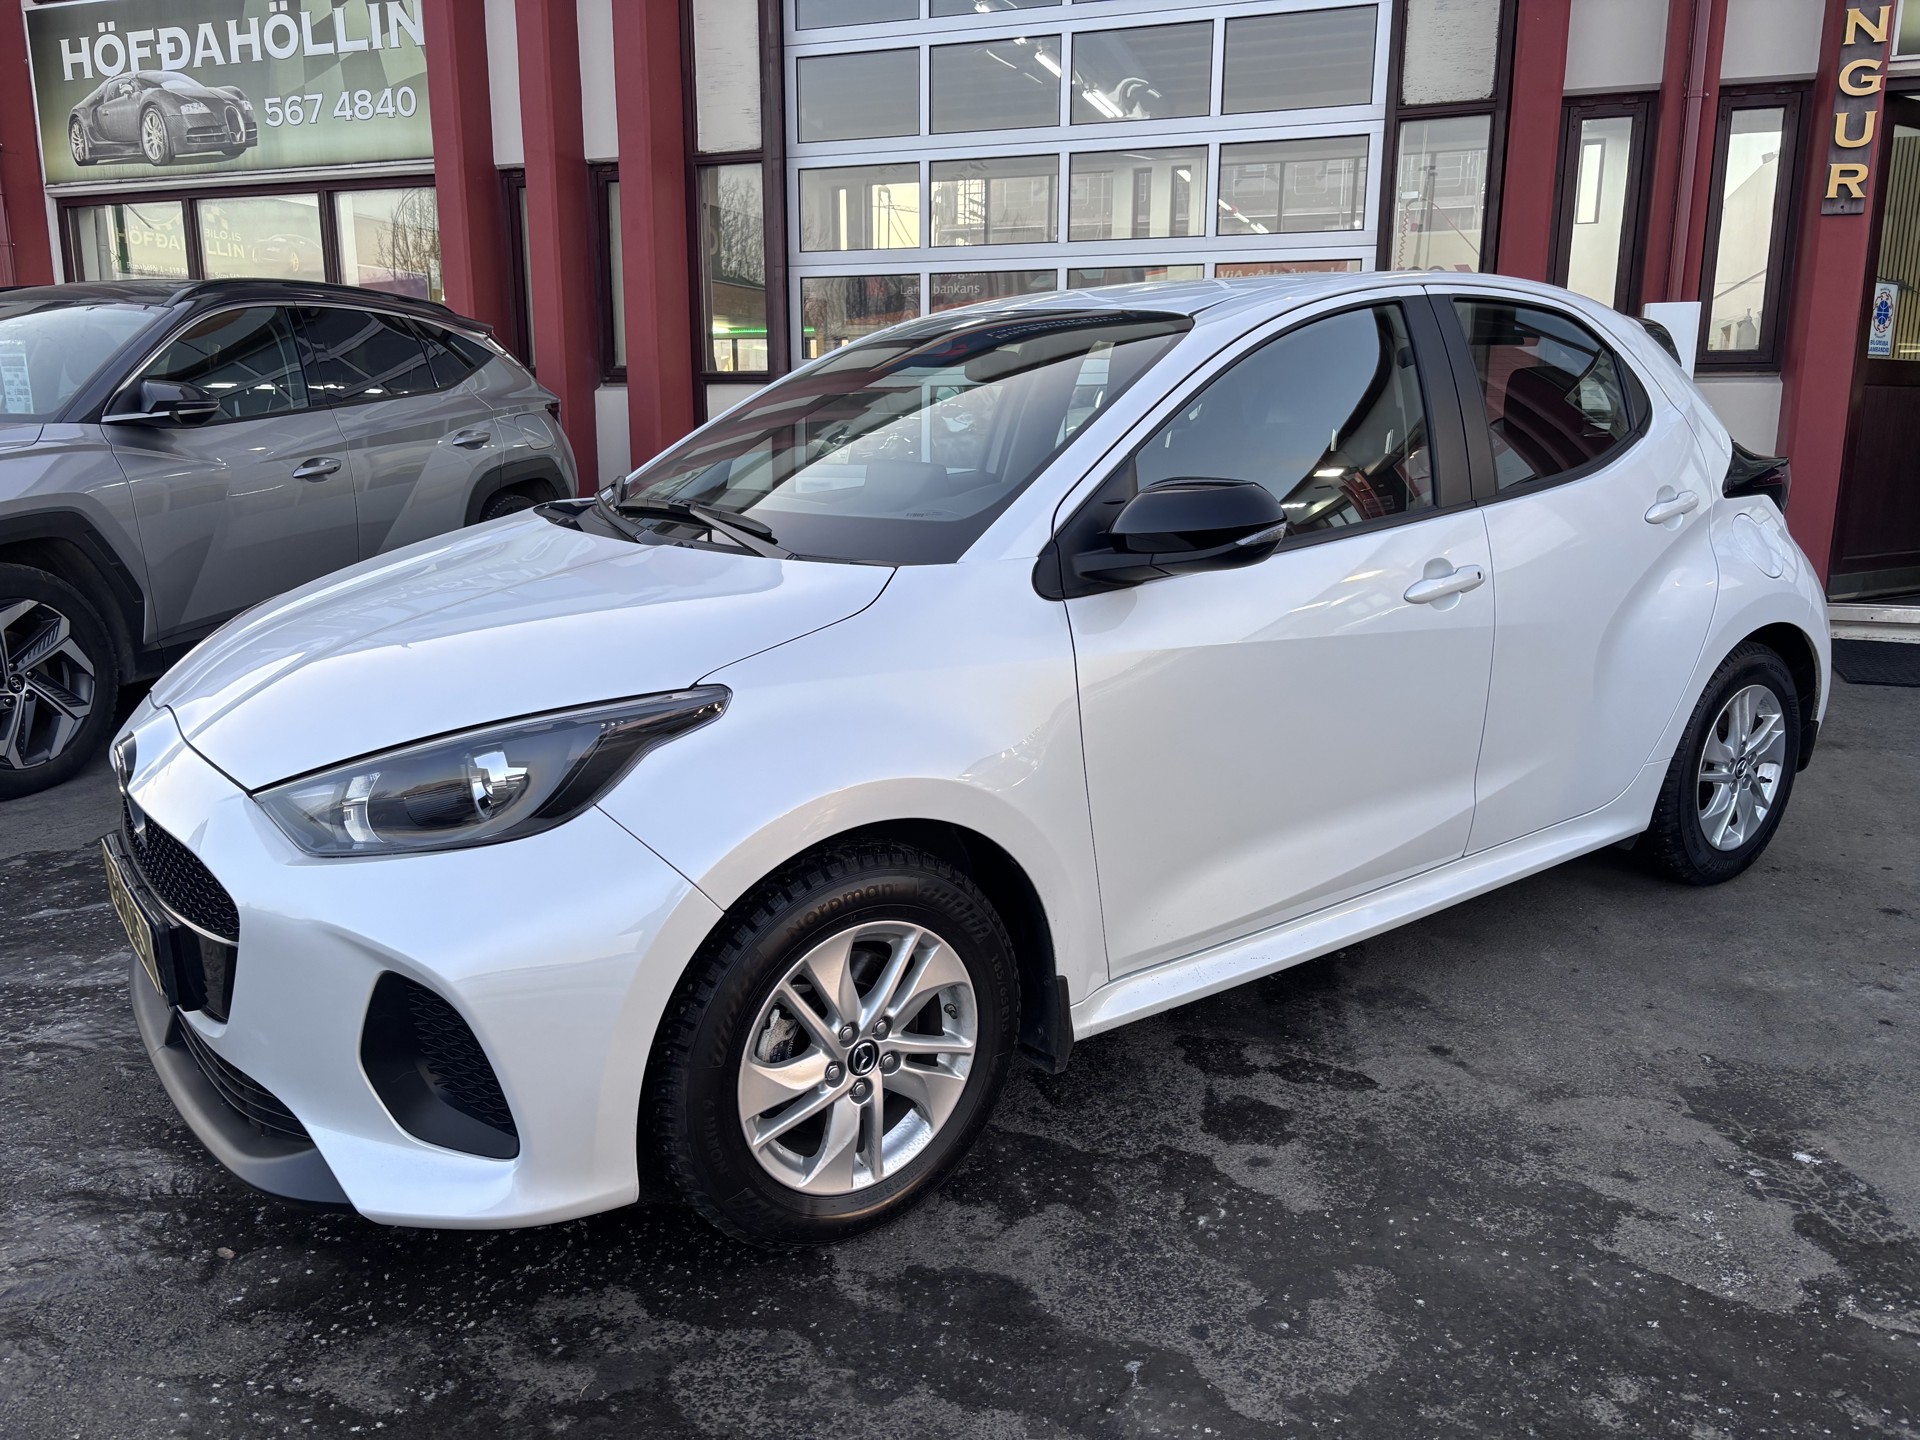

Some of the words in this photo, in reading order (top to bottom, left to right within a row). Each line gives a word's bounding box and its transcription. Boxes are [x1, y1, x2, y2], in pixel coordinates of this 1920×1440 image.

[59, 0, 426, 81] HÖFÐAHÖLLIN
[264, 93, 324, 128] 567
[332, 85, 418, 122] 4840
[1825, 5, 1891, 199] NGUR
